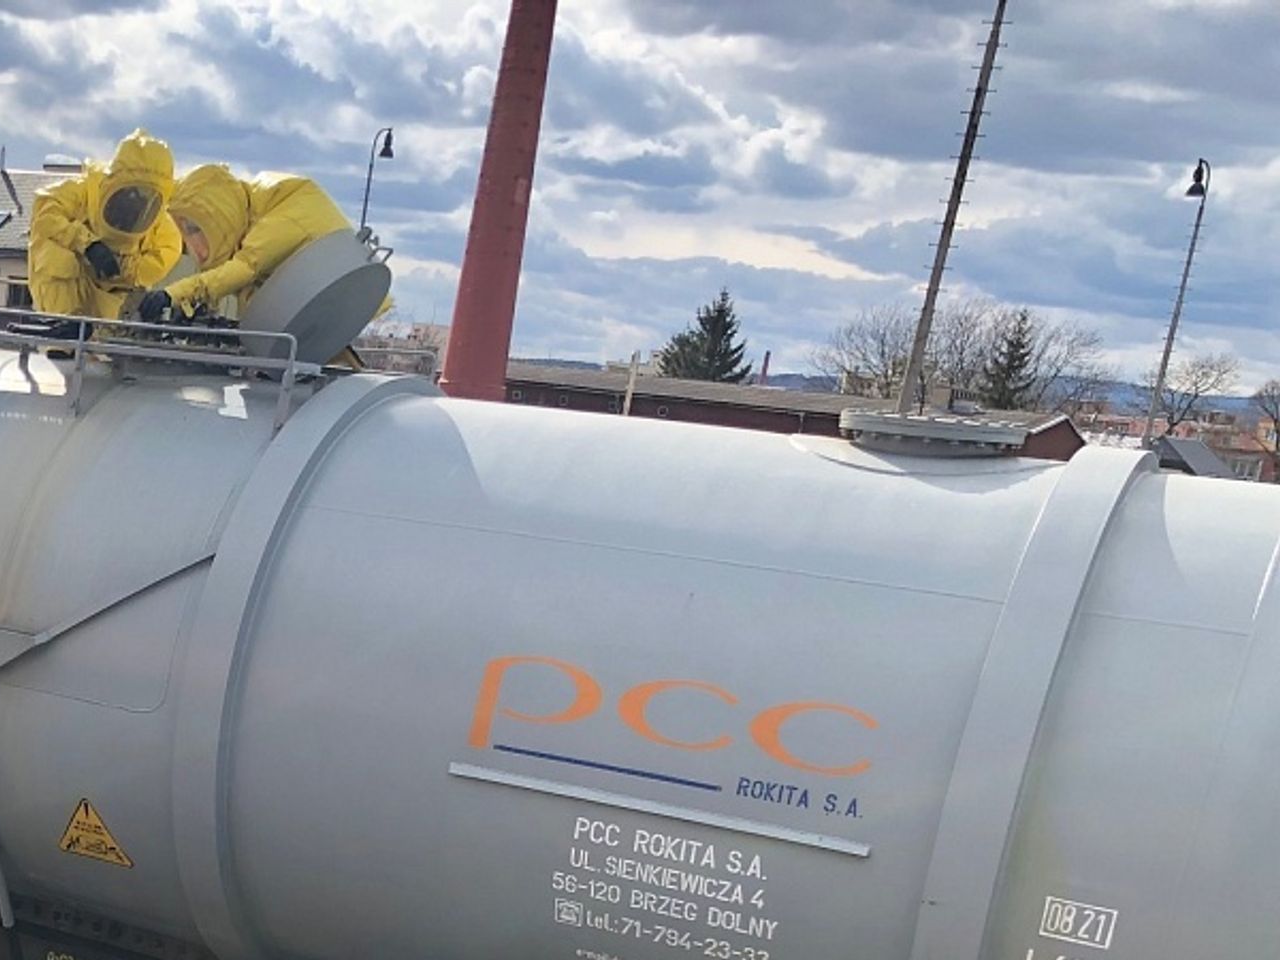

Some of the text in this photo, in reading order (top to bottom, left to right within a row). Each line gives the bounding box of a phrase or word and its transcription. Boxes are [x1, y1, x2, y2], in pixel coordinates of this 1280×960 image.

[736, 776, 863, 818] ROKITA S.A.
[570, 847, 766, 910] UL. SIENKIEWICZA 4
[574, 817, 768, 881] PCC ROKITA S.A.
[552, 870, 779, 941] 56-120 BRZEG DOLNY
